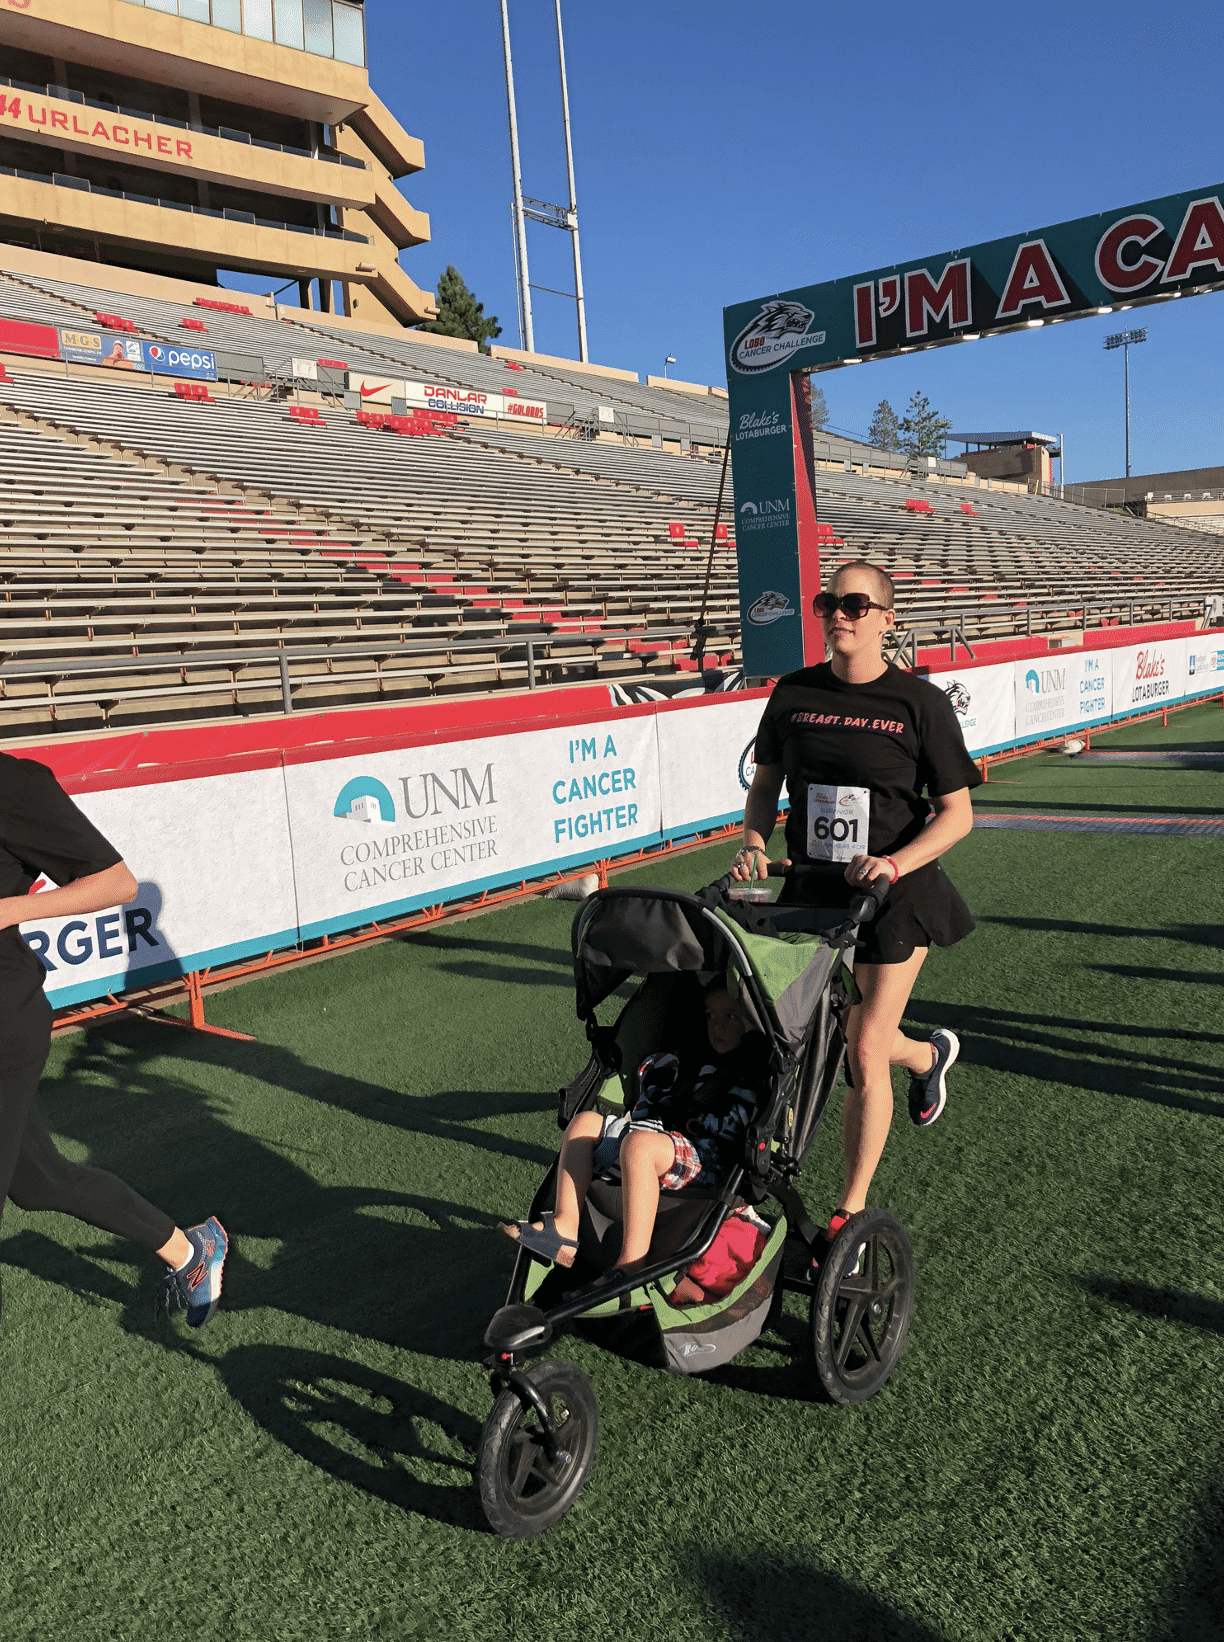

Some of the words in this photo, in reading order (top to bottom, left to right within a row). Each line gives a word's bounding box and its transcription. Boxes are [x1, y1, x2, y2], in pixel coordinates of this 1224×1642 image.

[28, 105, 193, 159] URLACHER
[995, 239, 1071, 319] A
[739, 346, 771, 358] CANCER
[773, 334, 823, 350] CHALLENGE
[744, 336, 765, 349] LOBO
[168, 350, 214, 370] pepsi
[424, 386, 487, 404] DANLAR
[428, 398, 484, 414] COLLISION
[507, 403, 543, 418] #GOLOBOS
[735, 424, 786, 440] LOTABURGER
[759, 499, 790, 514] UNM
[742, 513, 789, 524] COMPREHENSIVE
[742, 522, 765, 531] CANCER
[766, 520, 789, 528] CENTER
[1041, 668, 1066, 693] UNM
[1080, 677, 1105, 693] CANCER
[1132, 680, 1169, 702] LOTABURGER
[1080, 697, 1106, 714] FIGHTER
[569, 738, 597, 763] I'M
[603, 735, 617, 759] A
[398, 763, 498, 819] UNM
[552, 767, 637, 805] CANCER
[554, 803, 638, 844] FIGHTER
[814, 816, 858, 843] 601
[340, 815, 498, 866] COMPREHENSIVE
[344, 855, 426, 892] CANCER
[430, 838, 498, 873] CENTER
[22, 907, 160, 972] RGER
